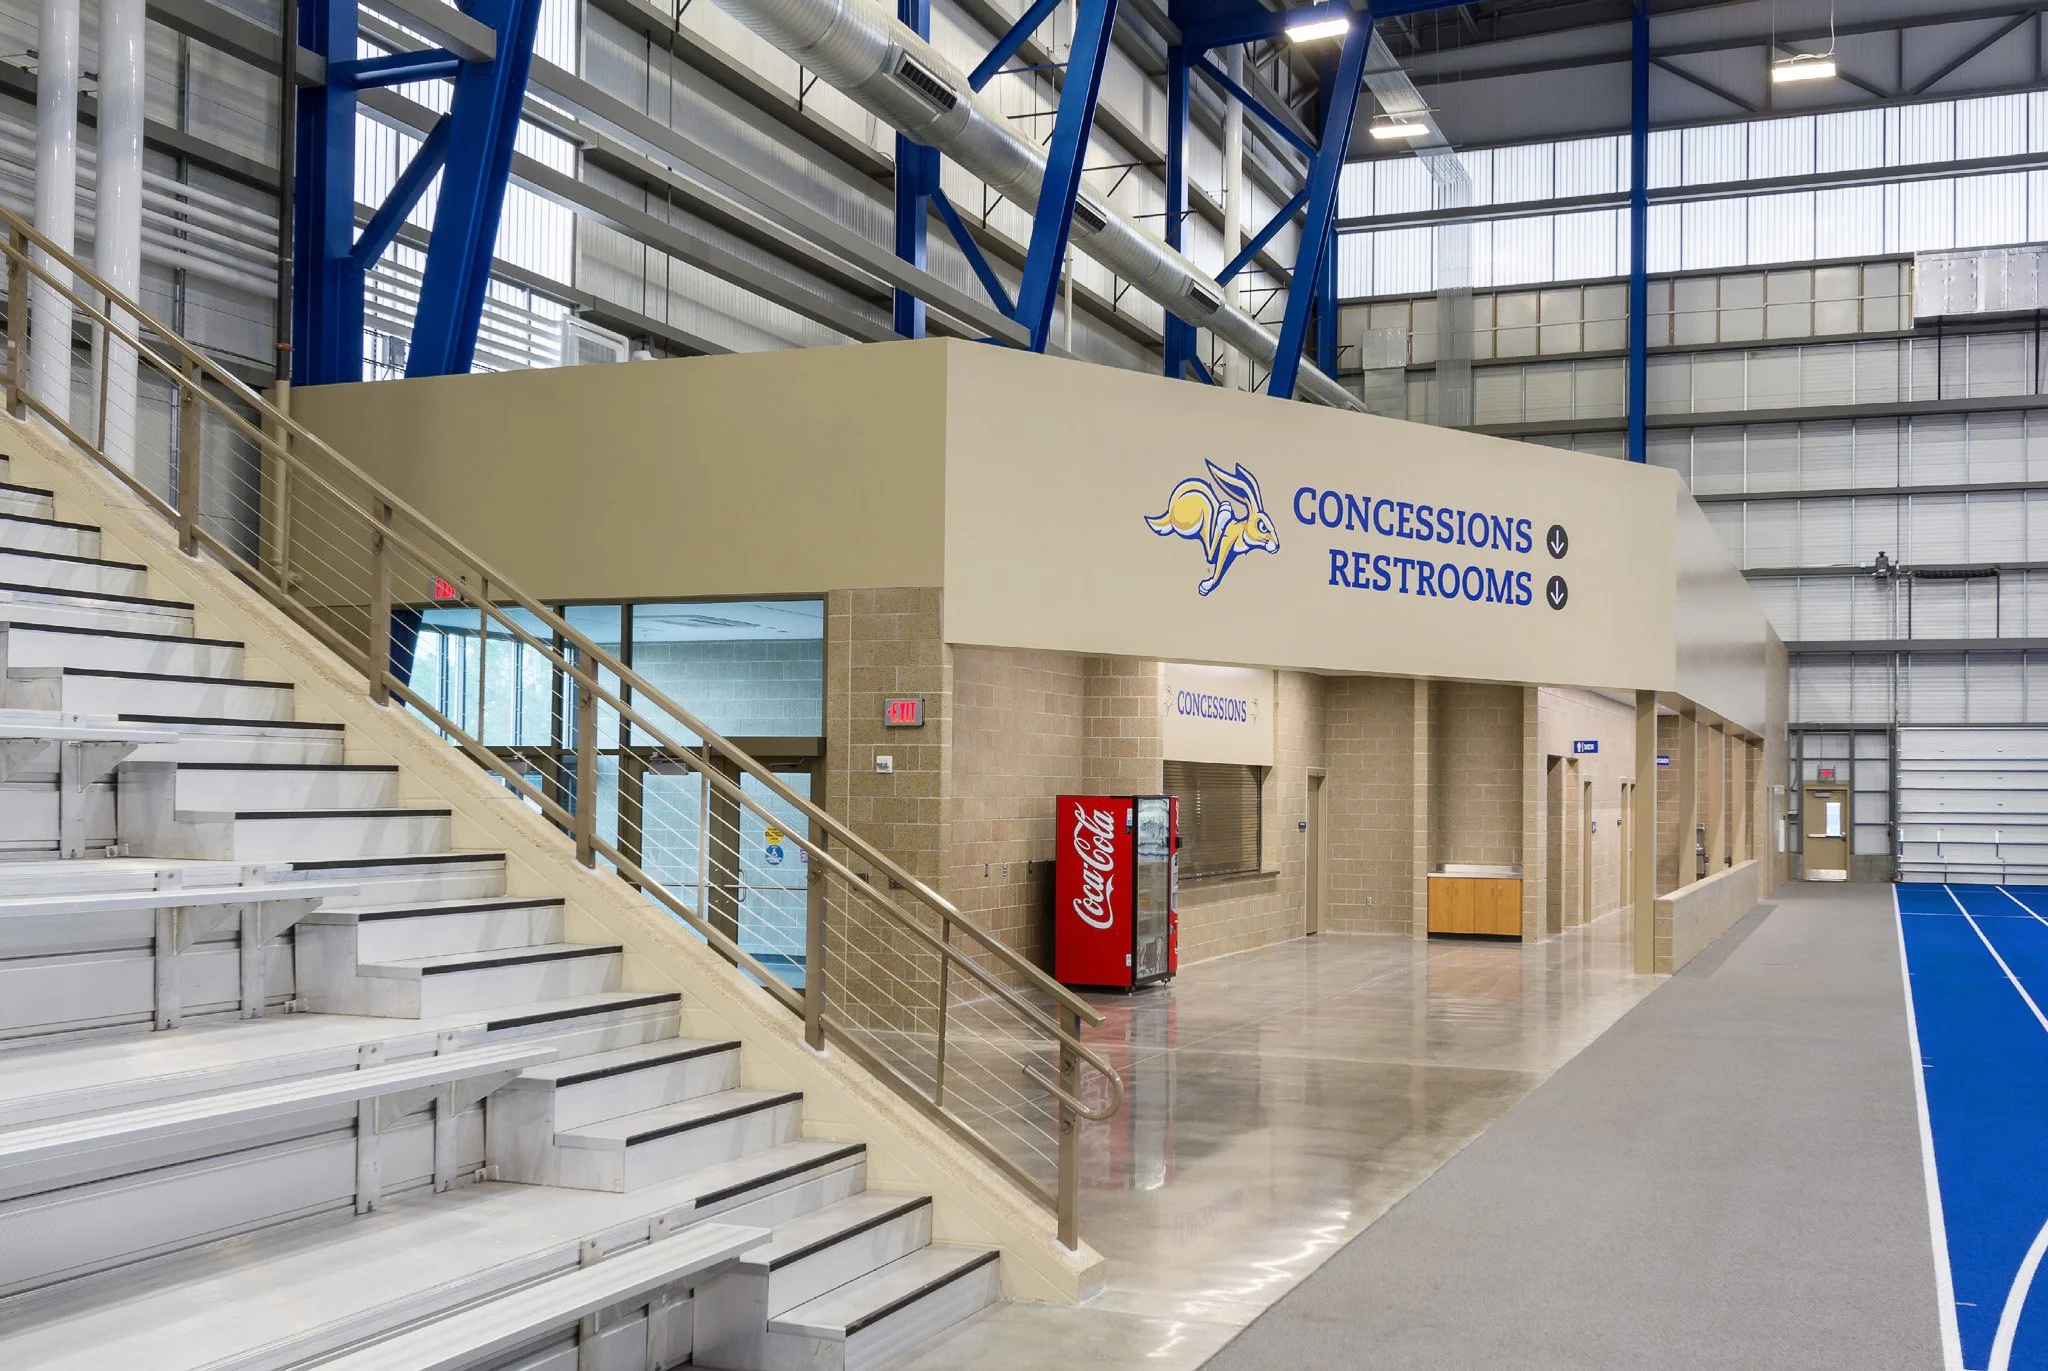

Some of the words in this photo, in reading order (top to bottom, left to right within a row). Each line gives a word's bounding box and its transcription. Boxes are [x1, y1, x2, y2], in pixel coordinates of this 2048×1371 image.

[1293, 487, 1533, 554] CONCESSIONS
[1328, 549, 1533, 606] RESTROOMS
[891, 701, 917, 723] EXIT
[1177, 690, 1247, 722] CONCESSIONS
